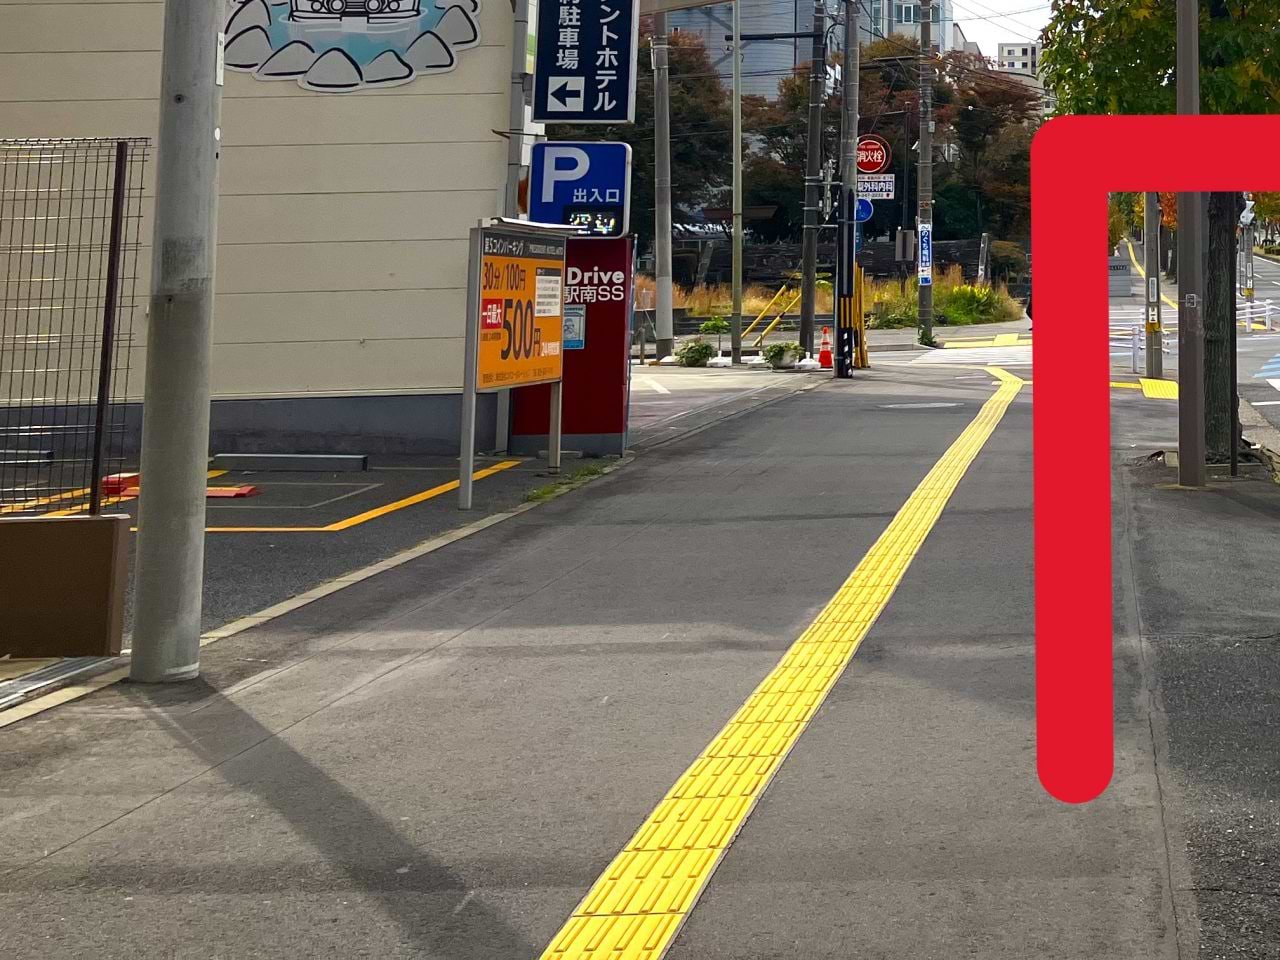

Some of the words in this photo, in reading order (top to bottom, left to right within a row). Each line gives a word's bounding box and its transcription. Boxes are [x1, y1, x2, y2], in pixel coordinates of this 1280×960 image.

[856, 150, 883, 162] 消火栓
[541, 147, 591, 203] P
[572, 188, 620, 203] 出入口
[567, 266, 625, 285] Drive
[563, 285, 625, 303] 駅南SS
